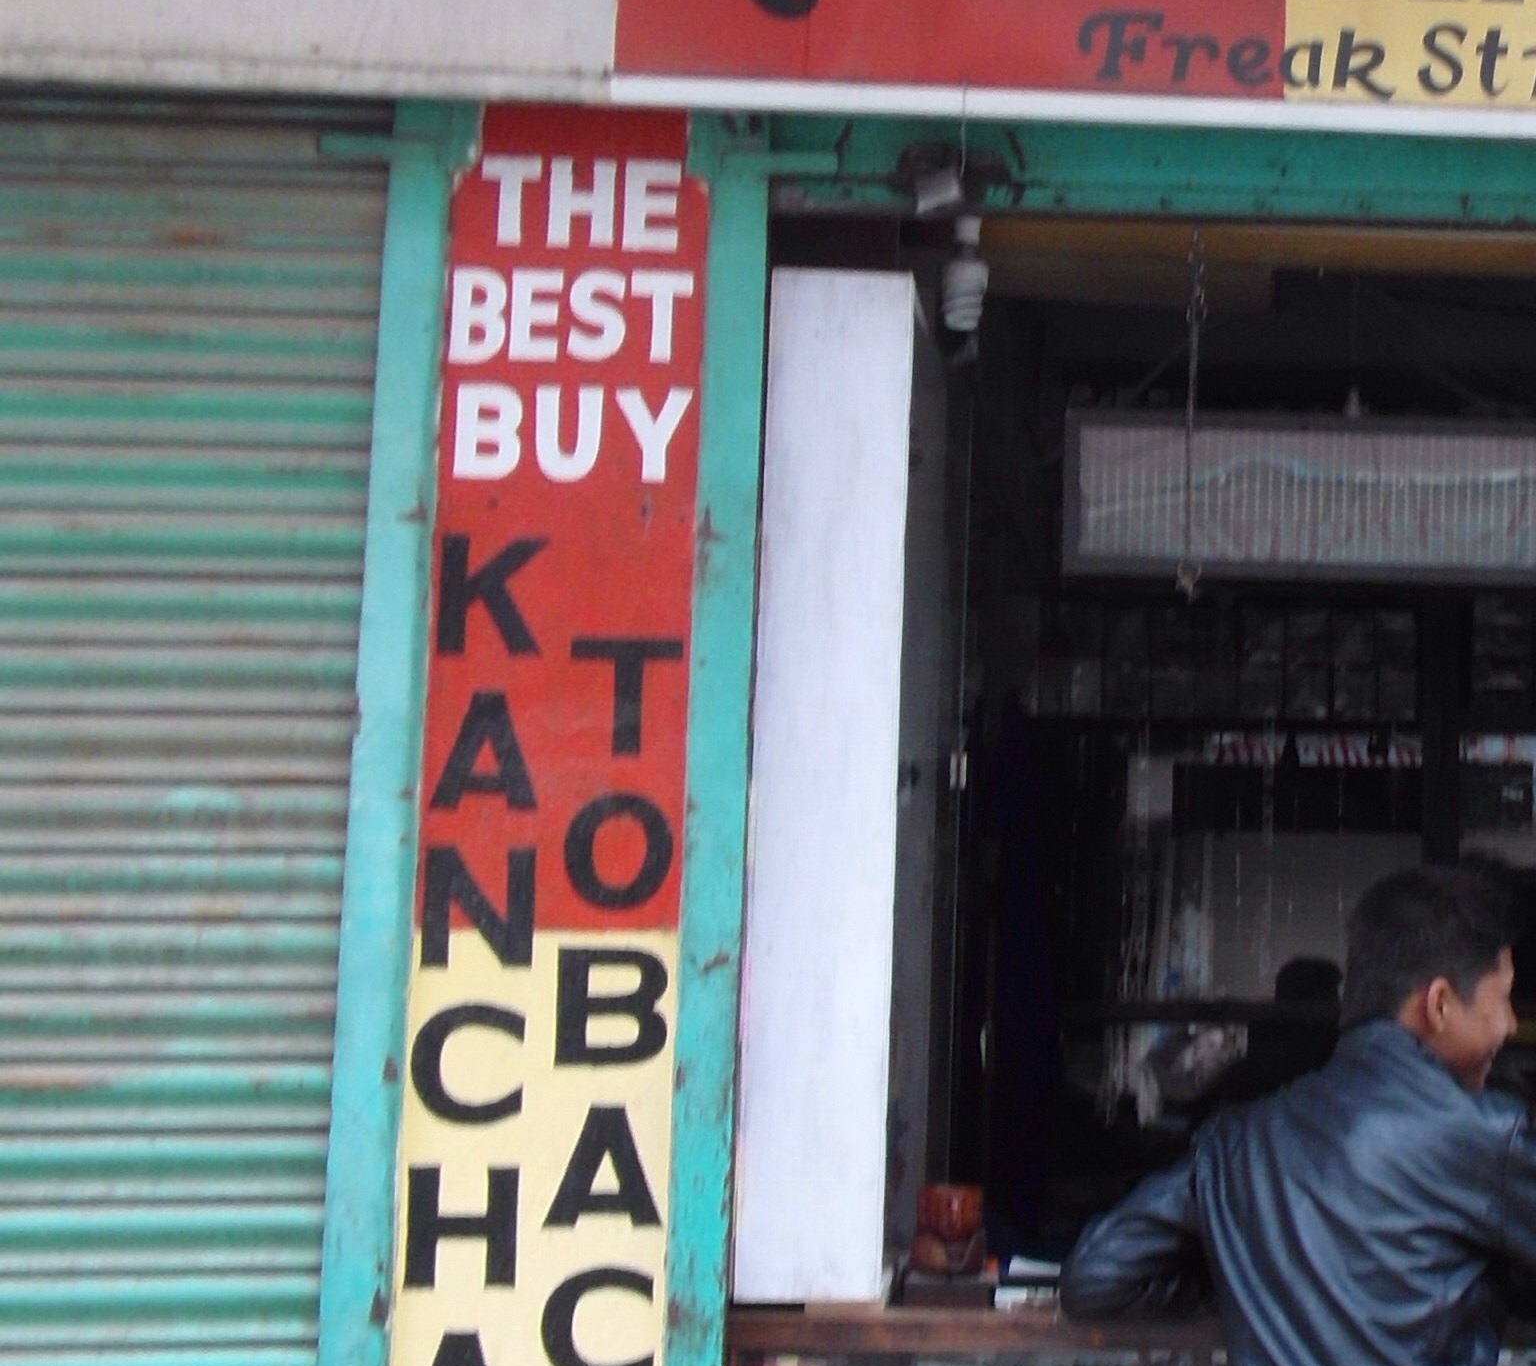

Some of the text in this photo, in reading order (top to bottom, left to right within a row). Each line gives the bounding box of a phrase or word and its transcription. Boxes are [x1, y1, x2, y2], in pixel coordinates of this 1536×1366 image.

[1077, 10, 1398, 101] Freak
[480, 154, 684, 254] THE
[446, 265, 695, 367] BEST
[451, 381, 695, 485] BUY
